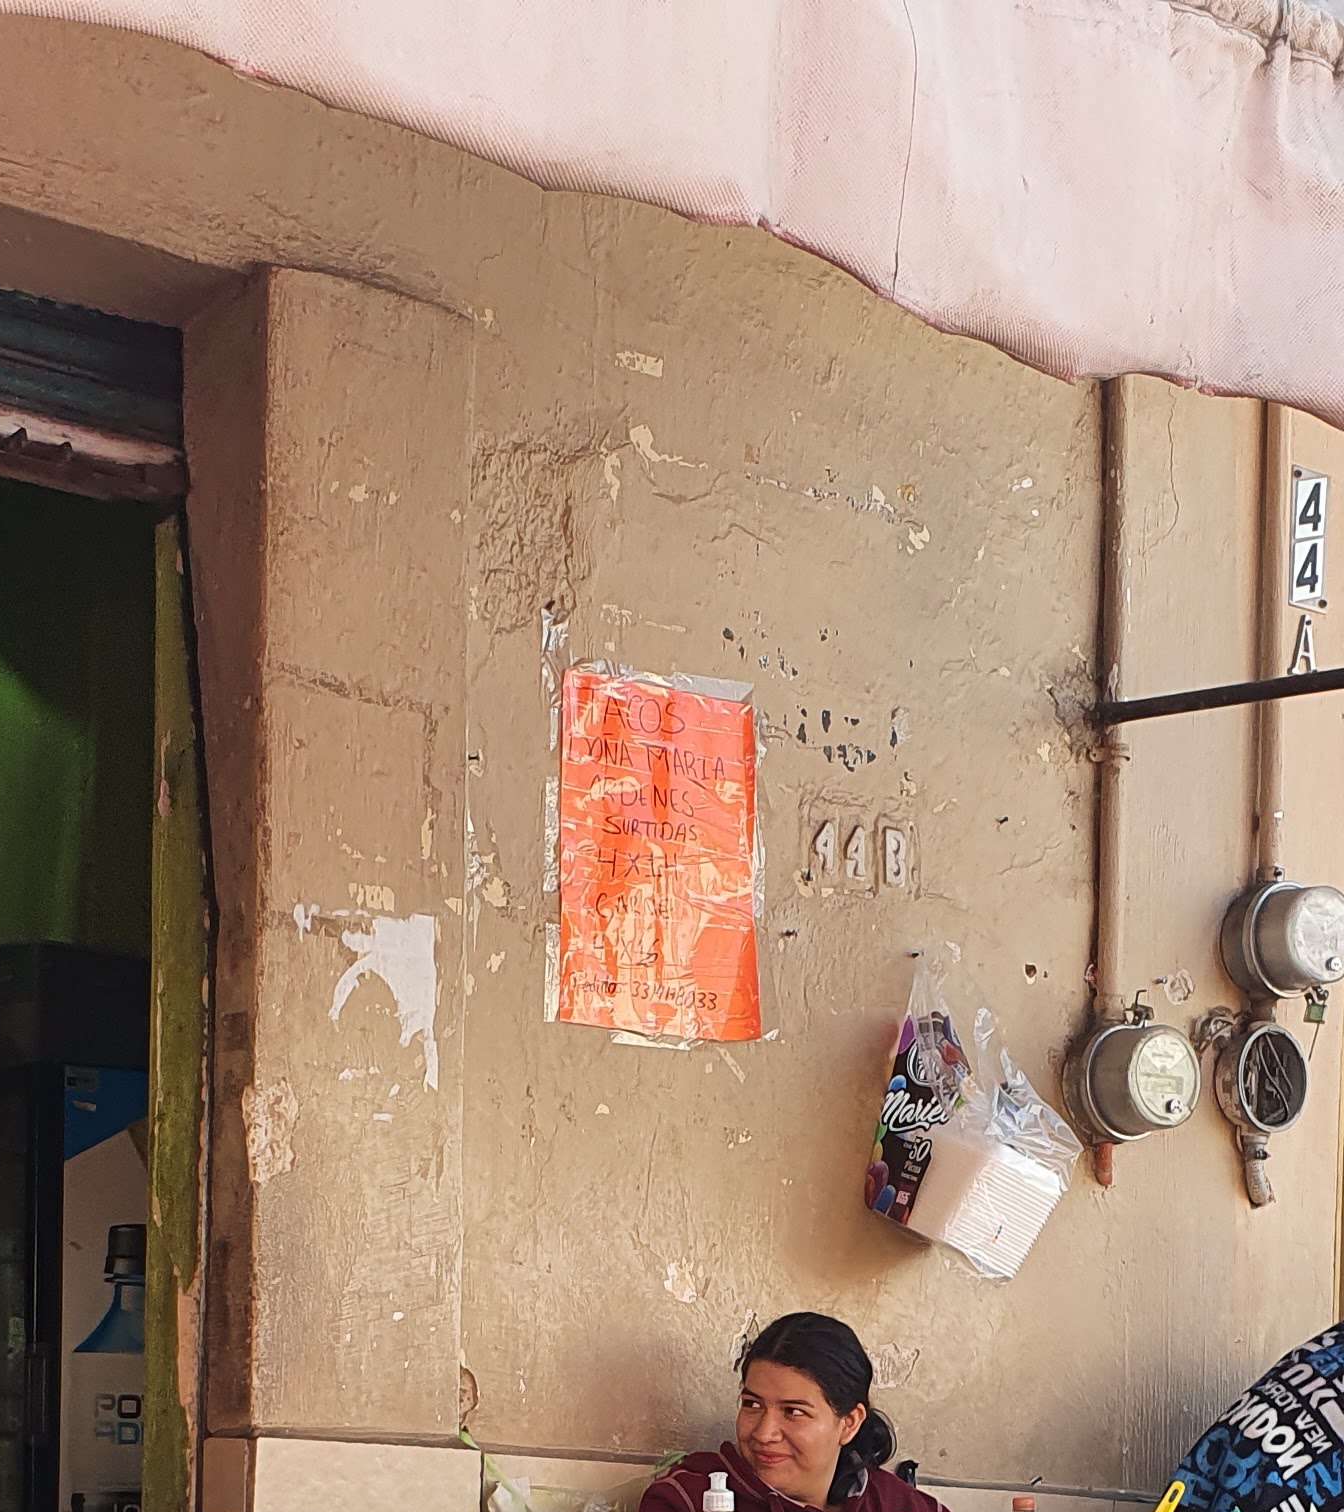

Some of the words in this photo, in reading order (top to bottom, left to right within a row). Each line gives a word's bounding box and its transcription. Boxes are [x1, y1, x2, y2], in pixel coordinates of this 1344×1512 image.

[574, 686, 686, 735] TACOS
[640, 742, 726, 782] MARIA
[601, 815, 698, 843] SURTIDAS
